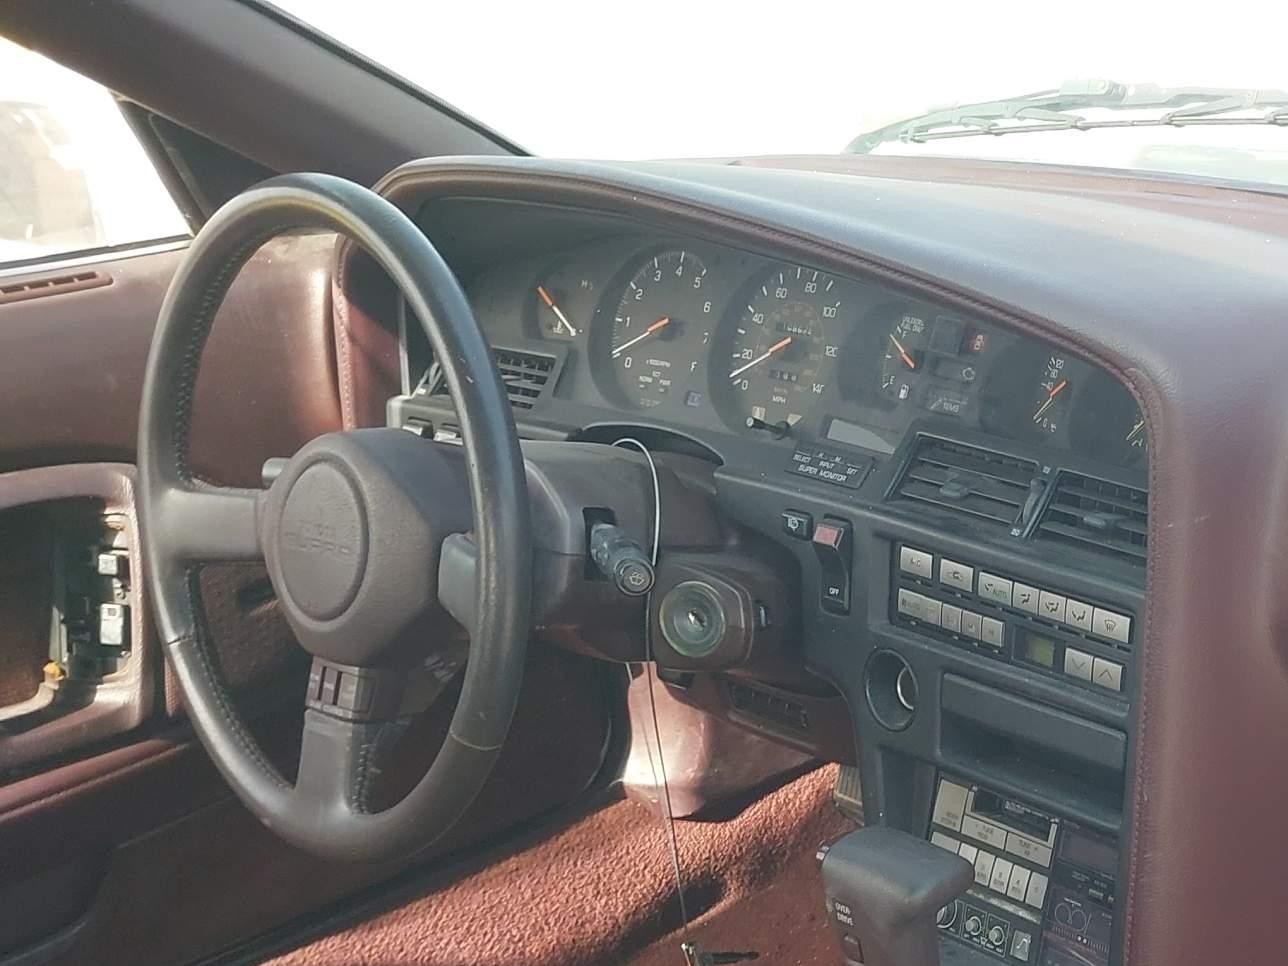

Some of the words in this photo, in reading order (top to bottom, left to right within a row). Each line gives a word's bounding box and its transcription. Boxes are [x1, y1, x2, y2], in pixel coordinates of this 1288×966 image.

[653, 270, 662, 281] 3
[675, 265, 683, 276] 4
[693, 277, 702, 288] 5
[804, 282, 817, 293] 80
[635, 288, 643, 300] 2
[775, 287, 788, 298] 60
[703, 301, 712, 313] 6
[823, 306, 837, 318] 100
[625, 316, 631, 327] 1
[752, 313, 764, 324] 40
[741, 348, 753, 360] 20
[624, 356, 632, 368] 0
[741, 379, 749, 391] 0
[798, 463, 819, 475] SUPER
[819, 470, 847, 482] MONITOR
[829, 587, 840, 596] OFF
